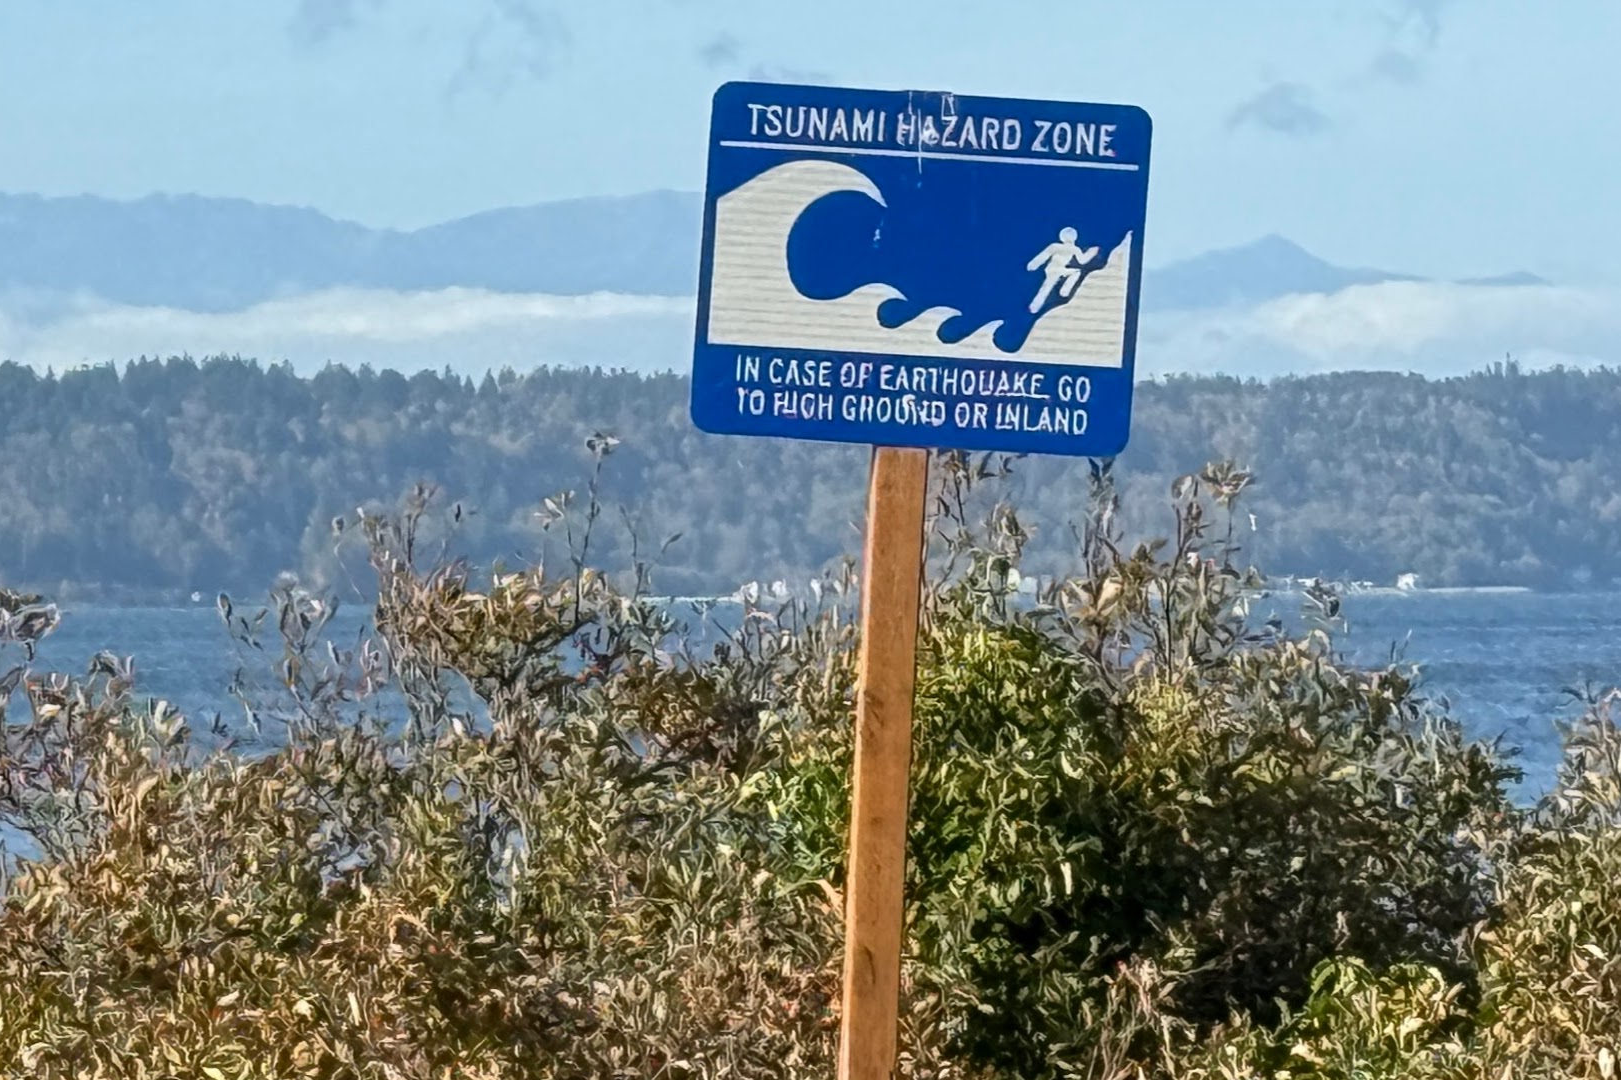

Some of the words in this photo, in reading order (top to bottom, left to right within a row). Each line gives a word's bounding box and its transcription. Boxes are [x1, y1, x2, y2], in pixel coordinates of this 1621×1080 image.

[747, 103, 886, 142] TSUNAMI
[896, 112, 1022, 150] HAZARD
[1031, 120, 1117, 158] ZONE
[736, 354, 760, 382] IN
[769, 358, 832, 387] CASE
[840, 362, 873, 388] OF
[880, 364, 1051, 399] EARTHQUAKE
[1058, 375, 1091, 403] GO
[737, 387, 766, 415] TO
[774, 391, 833, 421] HIGH
[842, 394, 946, 427] GROUND
[955, 402, 988, 430] OR
[995, 403, 1088, 435] INLAND
